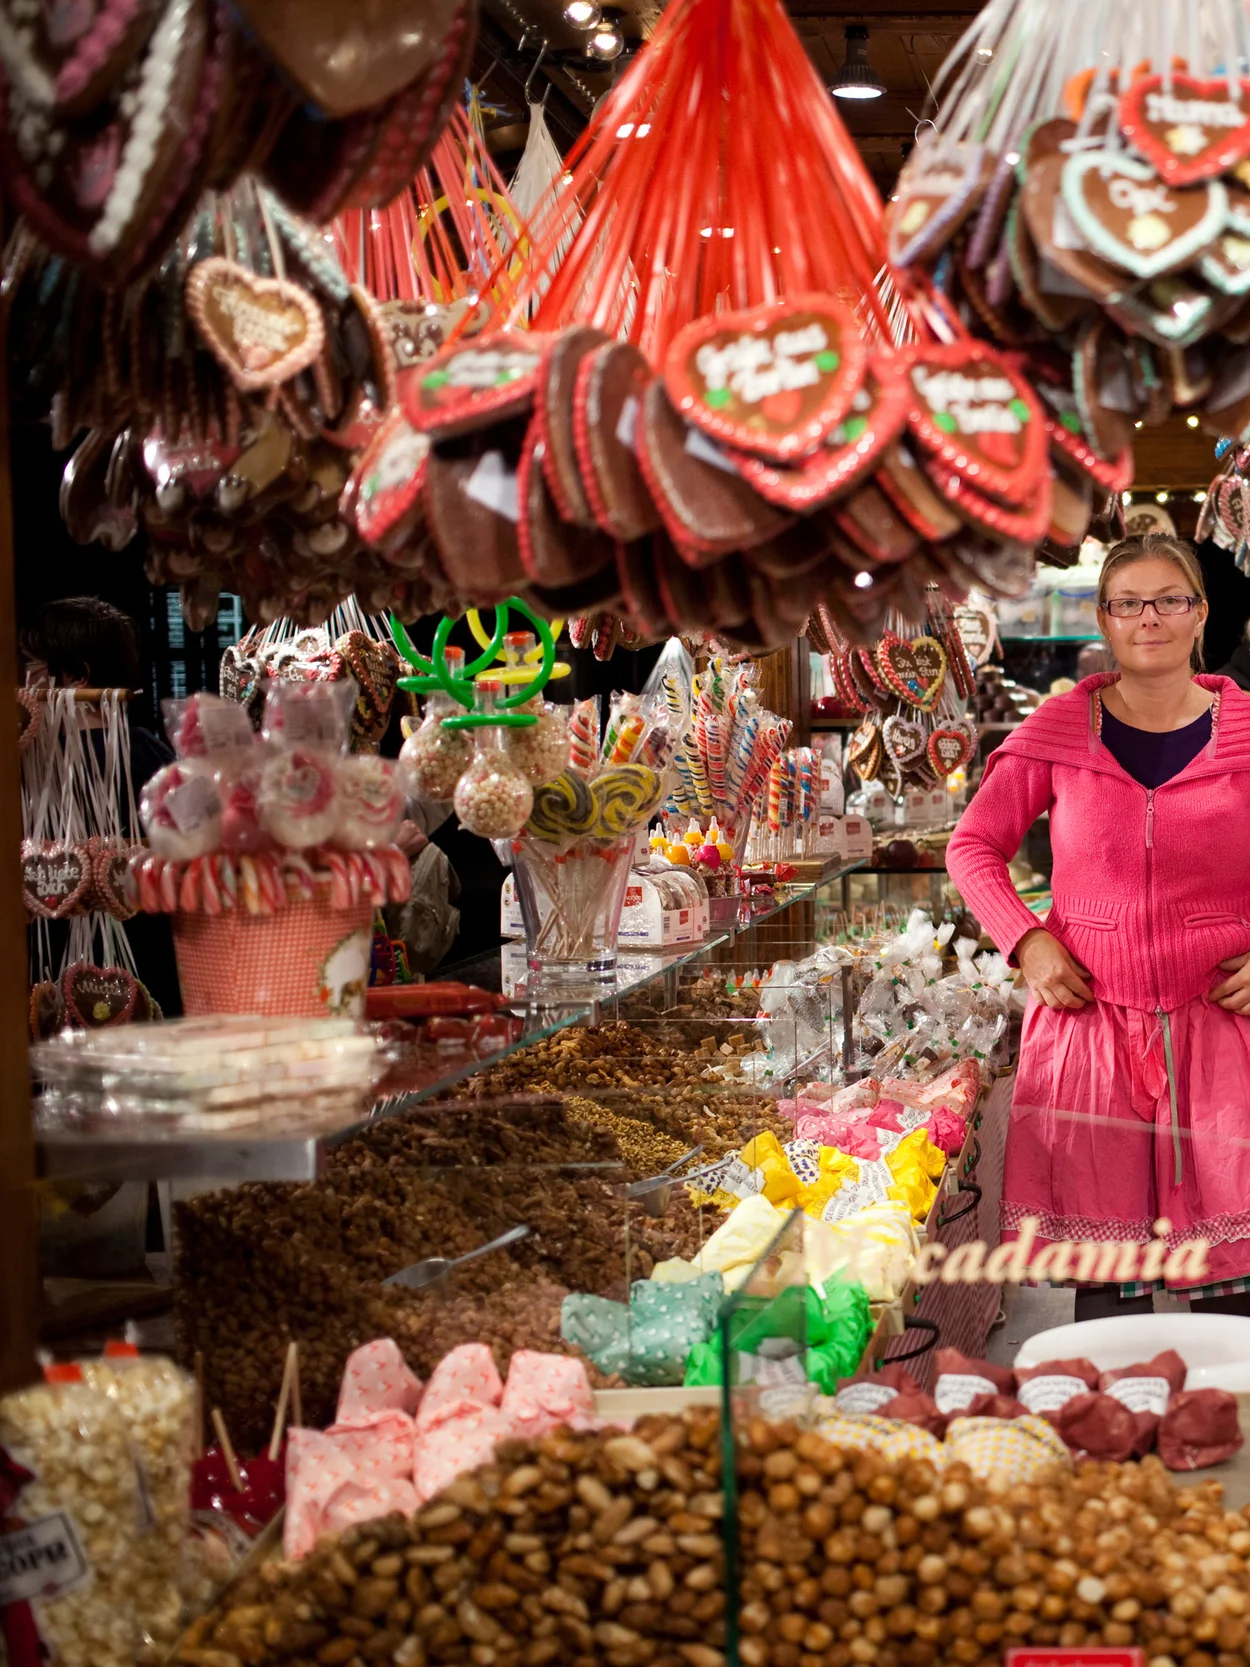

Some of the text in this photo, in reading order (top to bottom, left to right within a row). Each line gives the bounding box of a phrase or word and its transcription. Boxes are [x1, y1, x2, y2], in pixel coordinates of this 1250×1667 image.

[24, 863, 80, 882] Ich liebe
[36, 881, 69, 897] Dich
